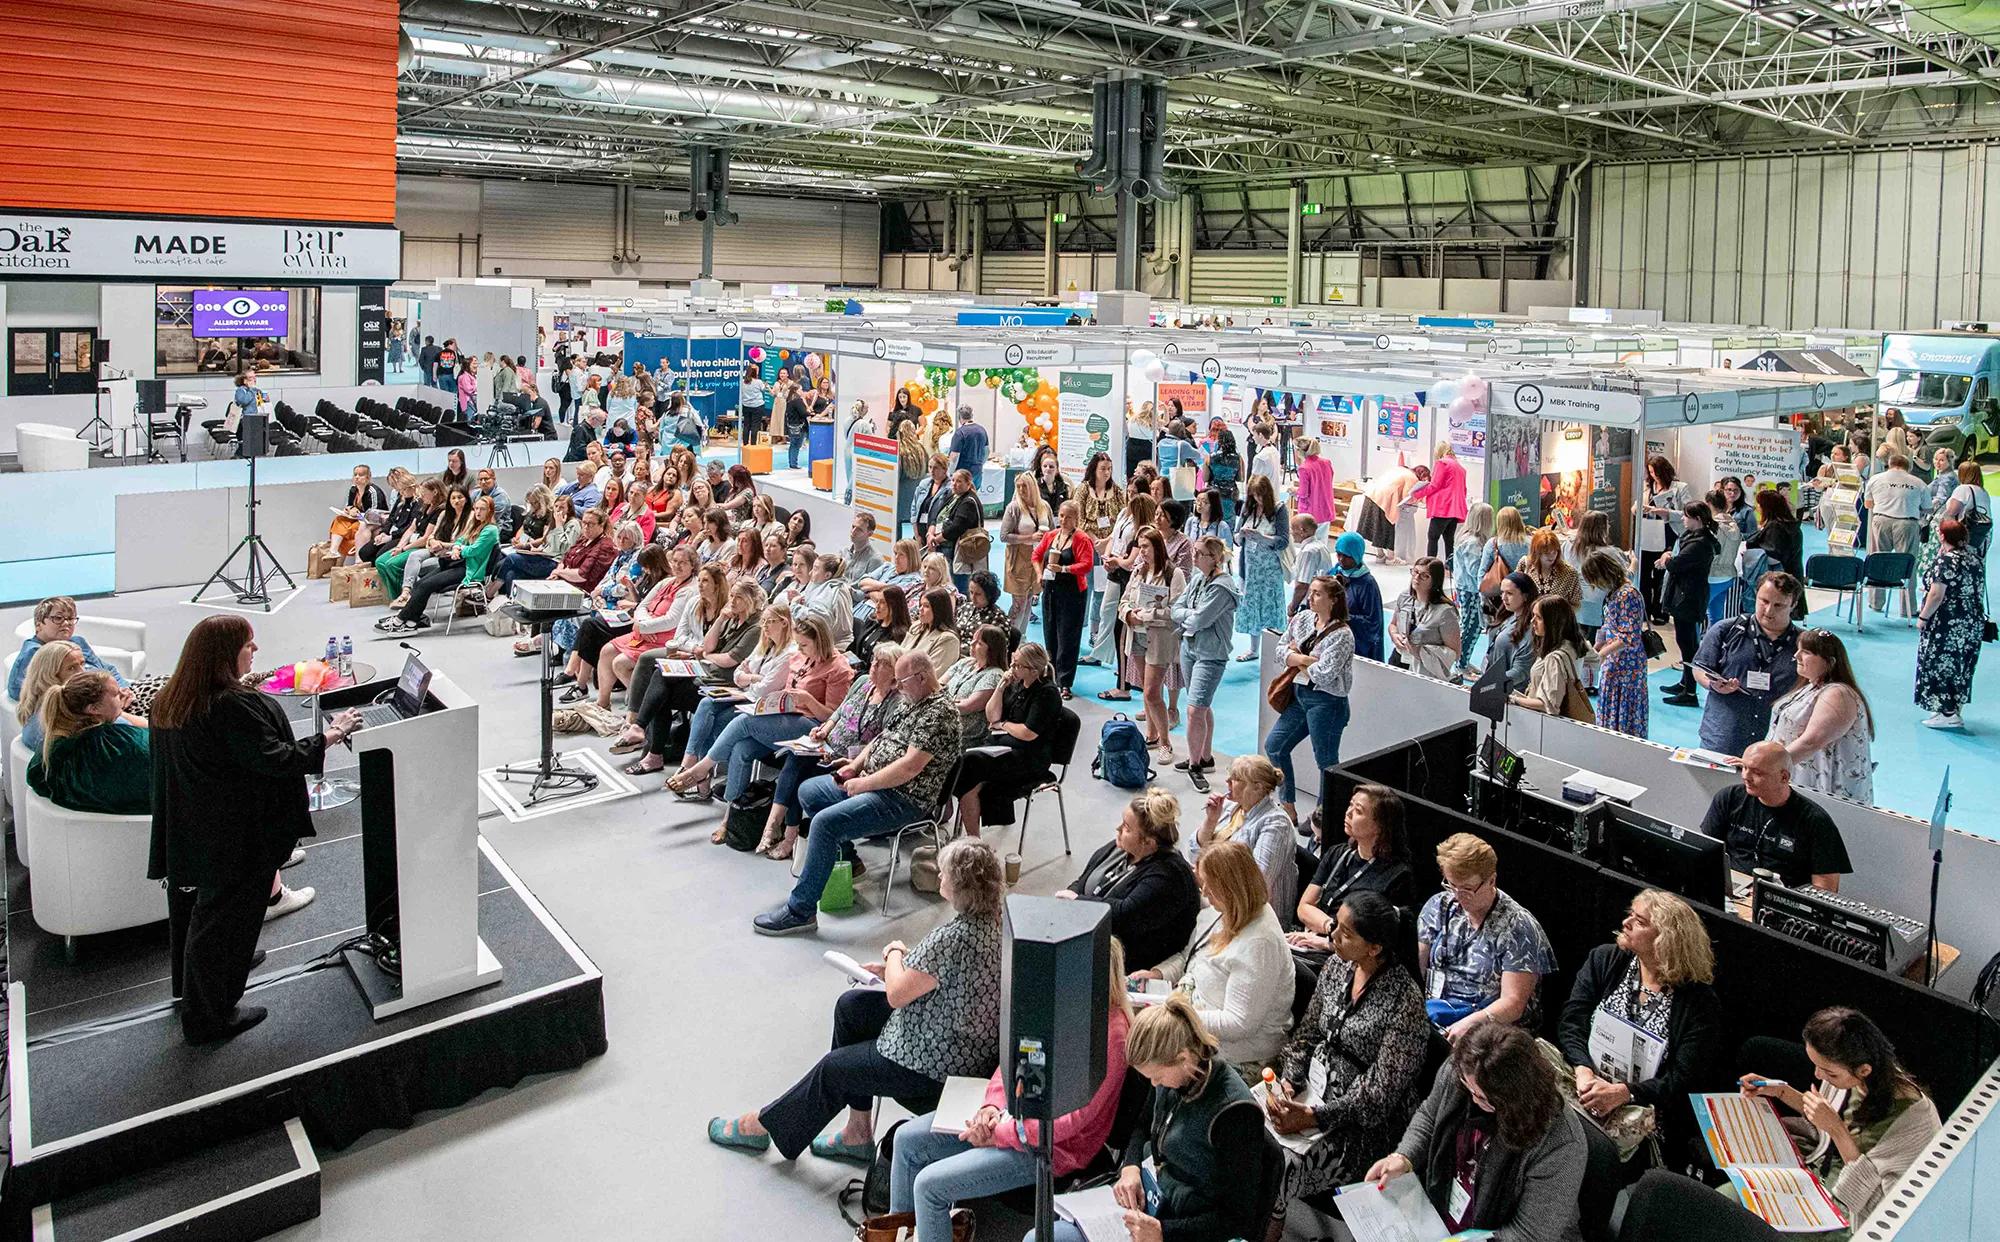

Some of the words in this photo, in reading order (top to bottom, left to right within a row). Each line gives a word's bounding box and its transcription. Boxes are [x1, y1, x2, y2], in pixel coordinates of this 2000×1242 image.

[1566, 5, 1579, 16] 13
[20, 222, 42, 232] the
[0, 227, 71, 253] Oak
[134, 235, 226, 254] MADE
[284, 230, 344, 254] Bar
[1205, 366, 1217, 374] A45
[1756, 358, 1778, 373] SK
[704, 369, 722, 378] and
[1224, 372, 1247, 380] Academy
[1250, 367, 1278, 376] Apprentice
[1520, 394, 1537, 404] A44
[1550, 398, 1566, 406] MBK
[1568, 400, 1600, 411] Training
[1718, 432, 1730, 440] Not
[1734, 434, 1754, 442] where
[1737, 444, 1766, 453] nursery
[1780, 446, 1793, 454] be?
[1762, 454, 1784, 462] about
[1715, 457, 1733, 465] Early
[1734, 459, 1754, 467] Years
[1756, 461, 1787, 471] Training
[1715, 465, 1760, 476] Consultancy
[1762, 470, 1794, 478] Services
[1781, 838, 1793, 847] PSP
[1772, 894, 1801, 910] YAMAHA
